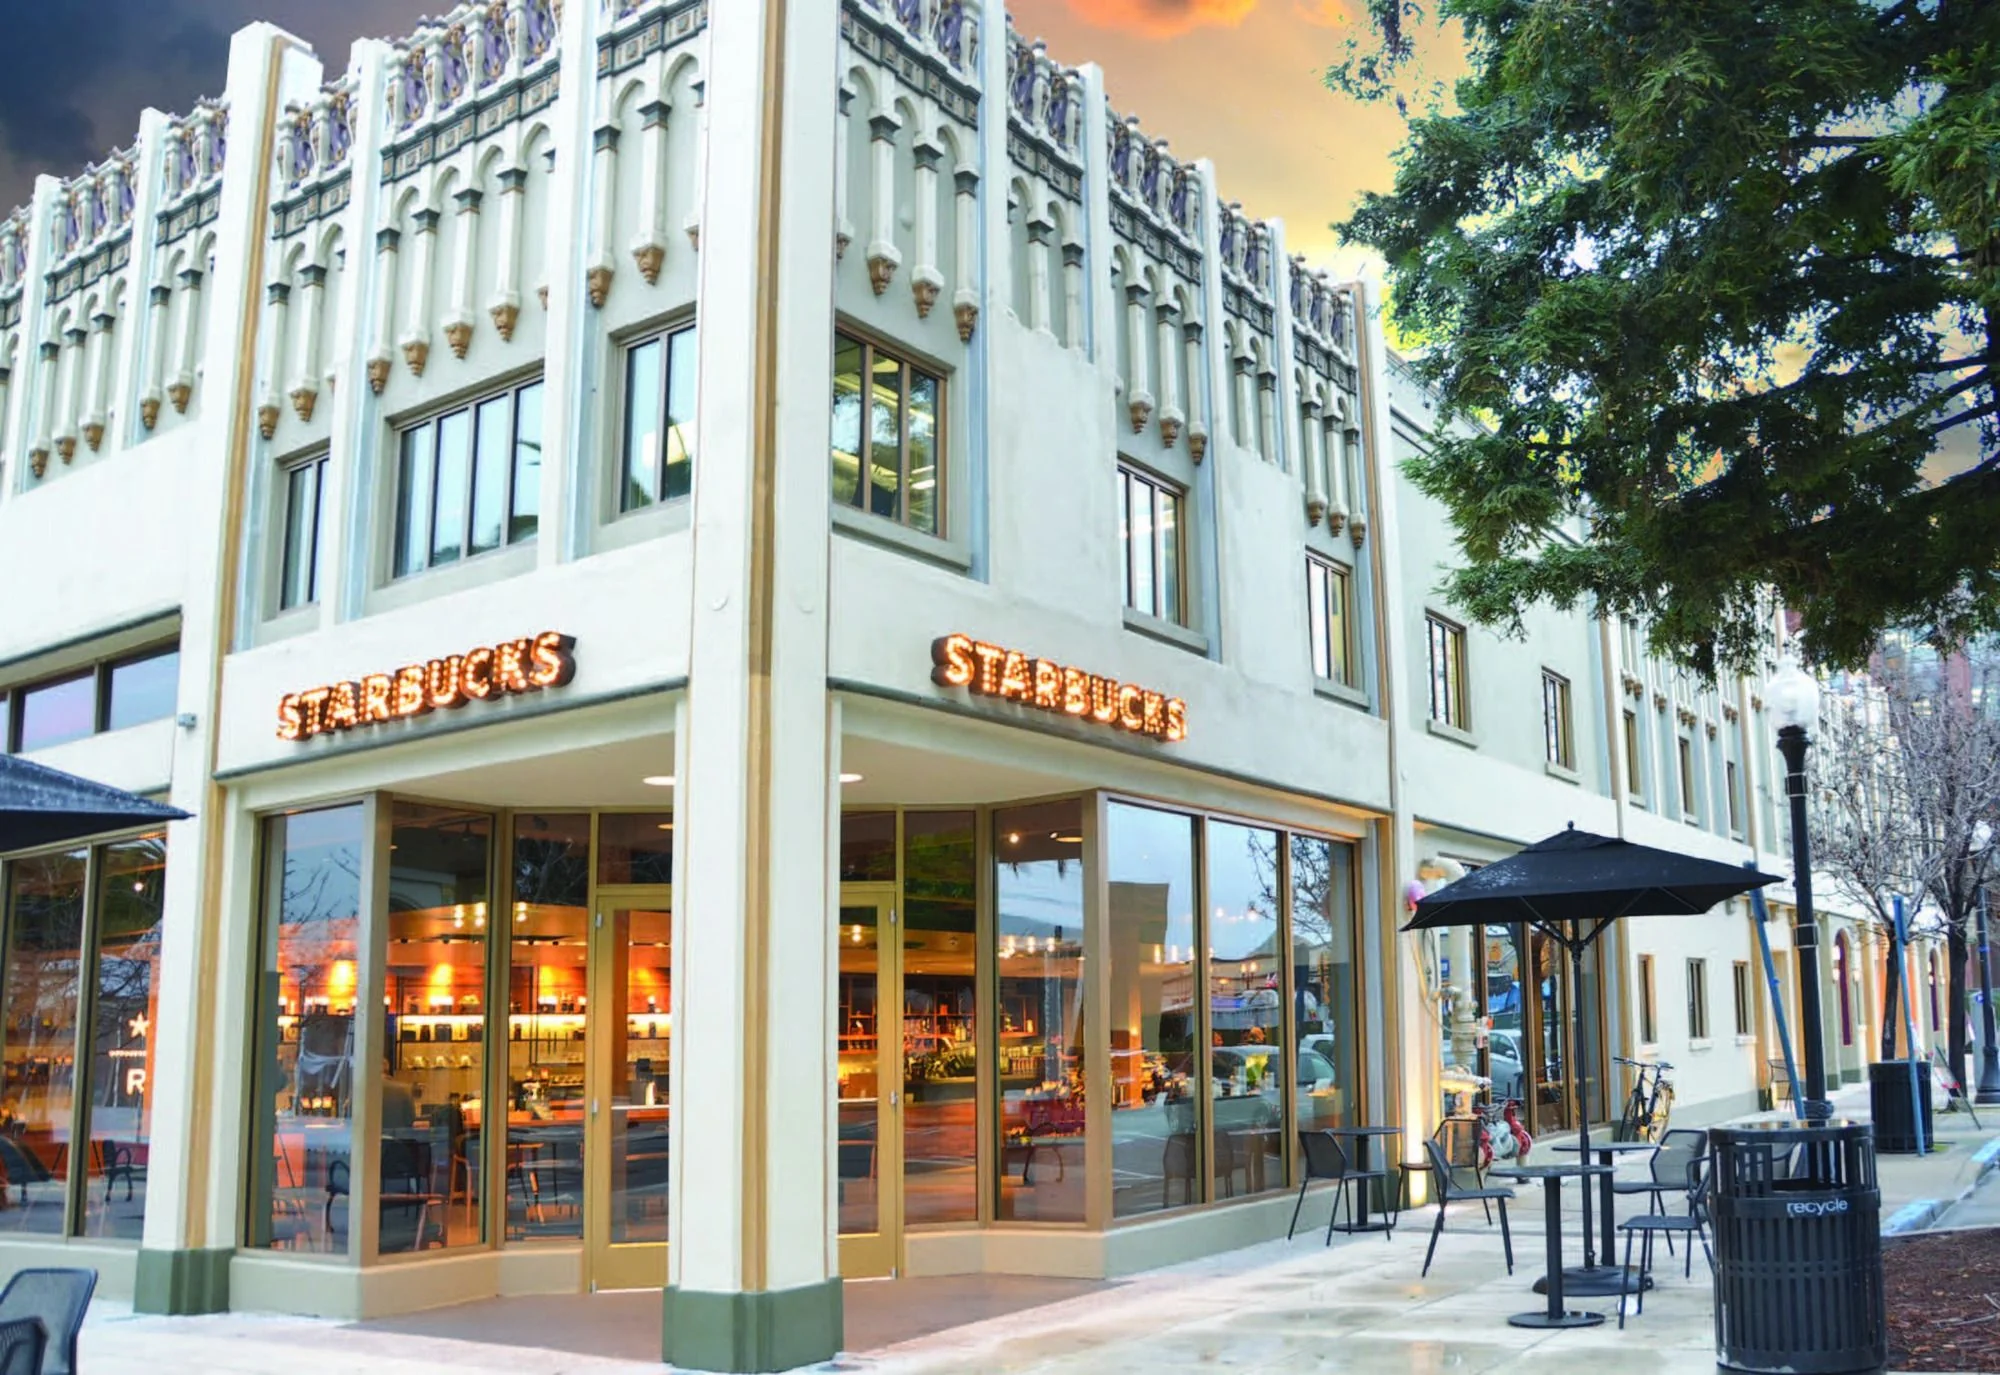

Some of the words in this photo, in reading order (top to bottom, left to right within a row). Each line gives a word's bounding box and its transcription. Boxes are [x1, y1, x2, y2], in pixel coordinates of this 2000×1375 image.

[277, 630, 576, 741] STARBUCKS
[932, 633, 1187, 742] STARBUCKS
[1786, 1198, 1848, 1217] recycle
